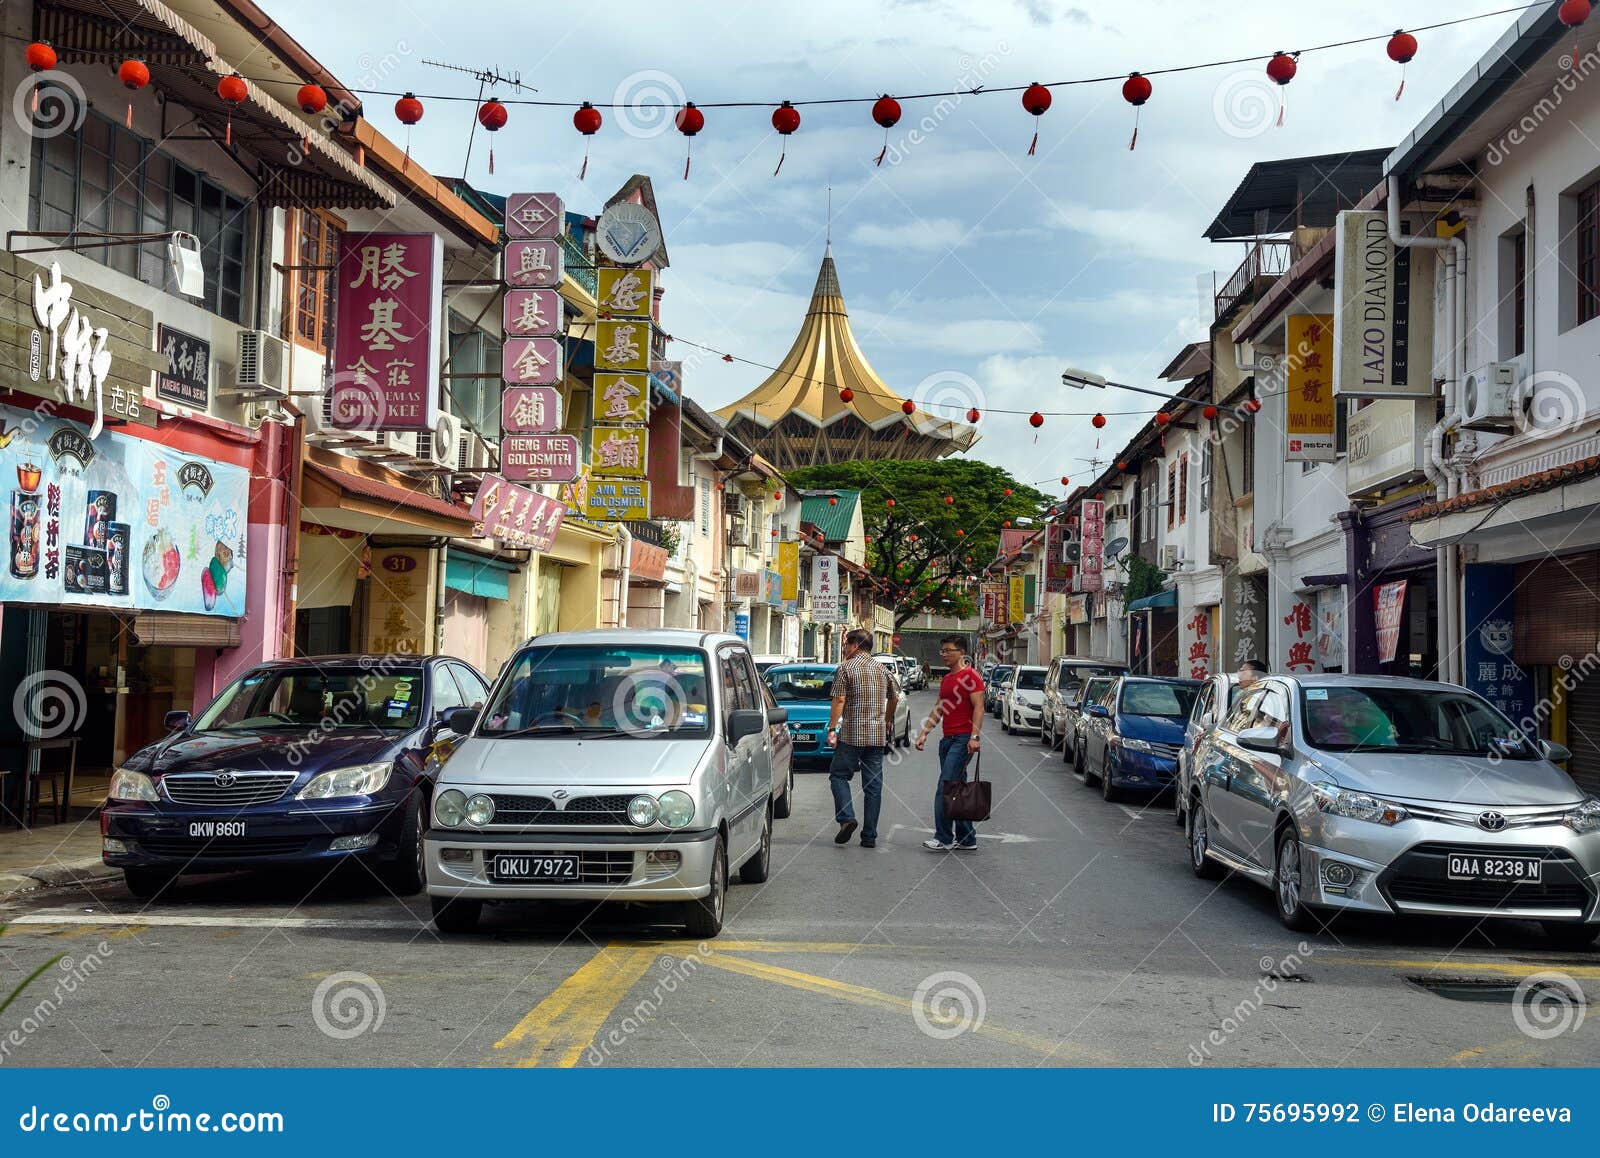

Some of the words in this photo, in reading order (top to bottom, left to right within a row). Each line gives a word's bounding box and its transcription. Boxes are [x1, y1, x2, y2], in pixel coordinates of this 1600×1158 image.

[1365, 218, 1388, 321] DIAMOND
[350, 242, 421, 350] 勝基
[1363, 328, 1385, 384] LAZO
[340, 391, 379, 401] KEDAI
[386, 391, 420, 401] EMAS
[340, 403, 379, 417] SHIN
[388, 403, 419, 417] KEE
[1290, 413, 1306, 427] WAI
[1311, 413, 1333, 428] HING
[511, 439, 540, 451] HENG
[547, 439, 569, 451] KEE
[508, 454, 572, 466] GOLDSMITH
[527, 468, 552, 477] 29
[596, 485, 616, 495] ANN
[622, 486, 641, 495] KEE
[590, 497, 645, 507] GOLDSMITH
[607, 509, 628, 517] 27
[391, 557, 406, 570] 31
[1490, 632, 1508, 641] LS
[190, 822, 214, 837] QKW
[216, 822, 245, 837] 8601
[500, 859, 529, 875] QKU
[534, 859, 573, 876] 7972
[1451, 858, 1479, 874] QAA
[1484, 860, 1523, 876] 8238
[1528, 862, 1538, 877] N
